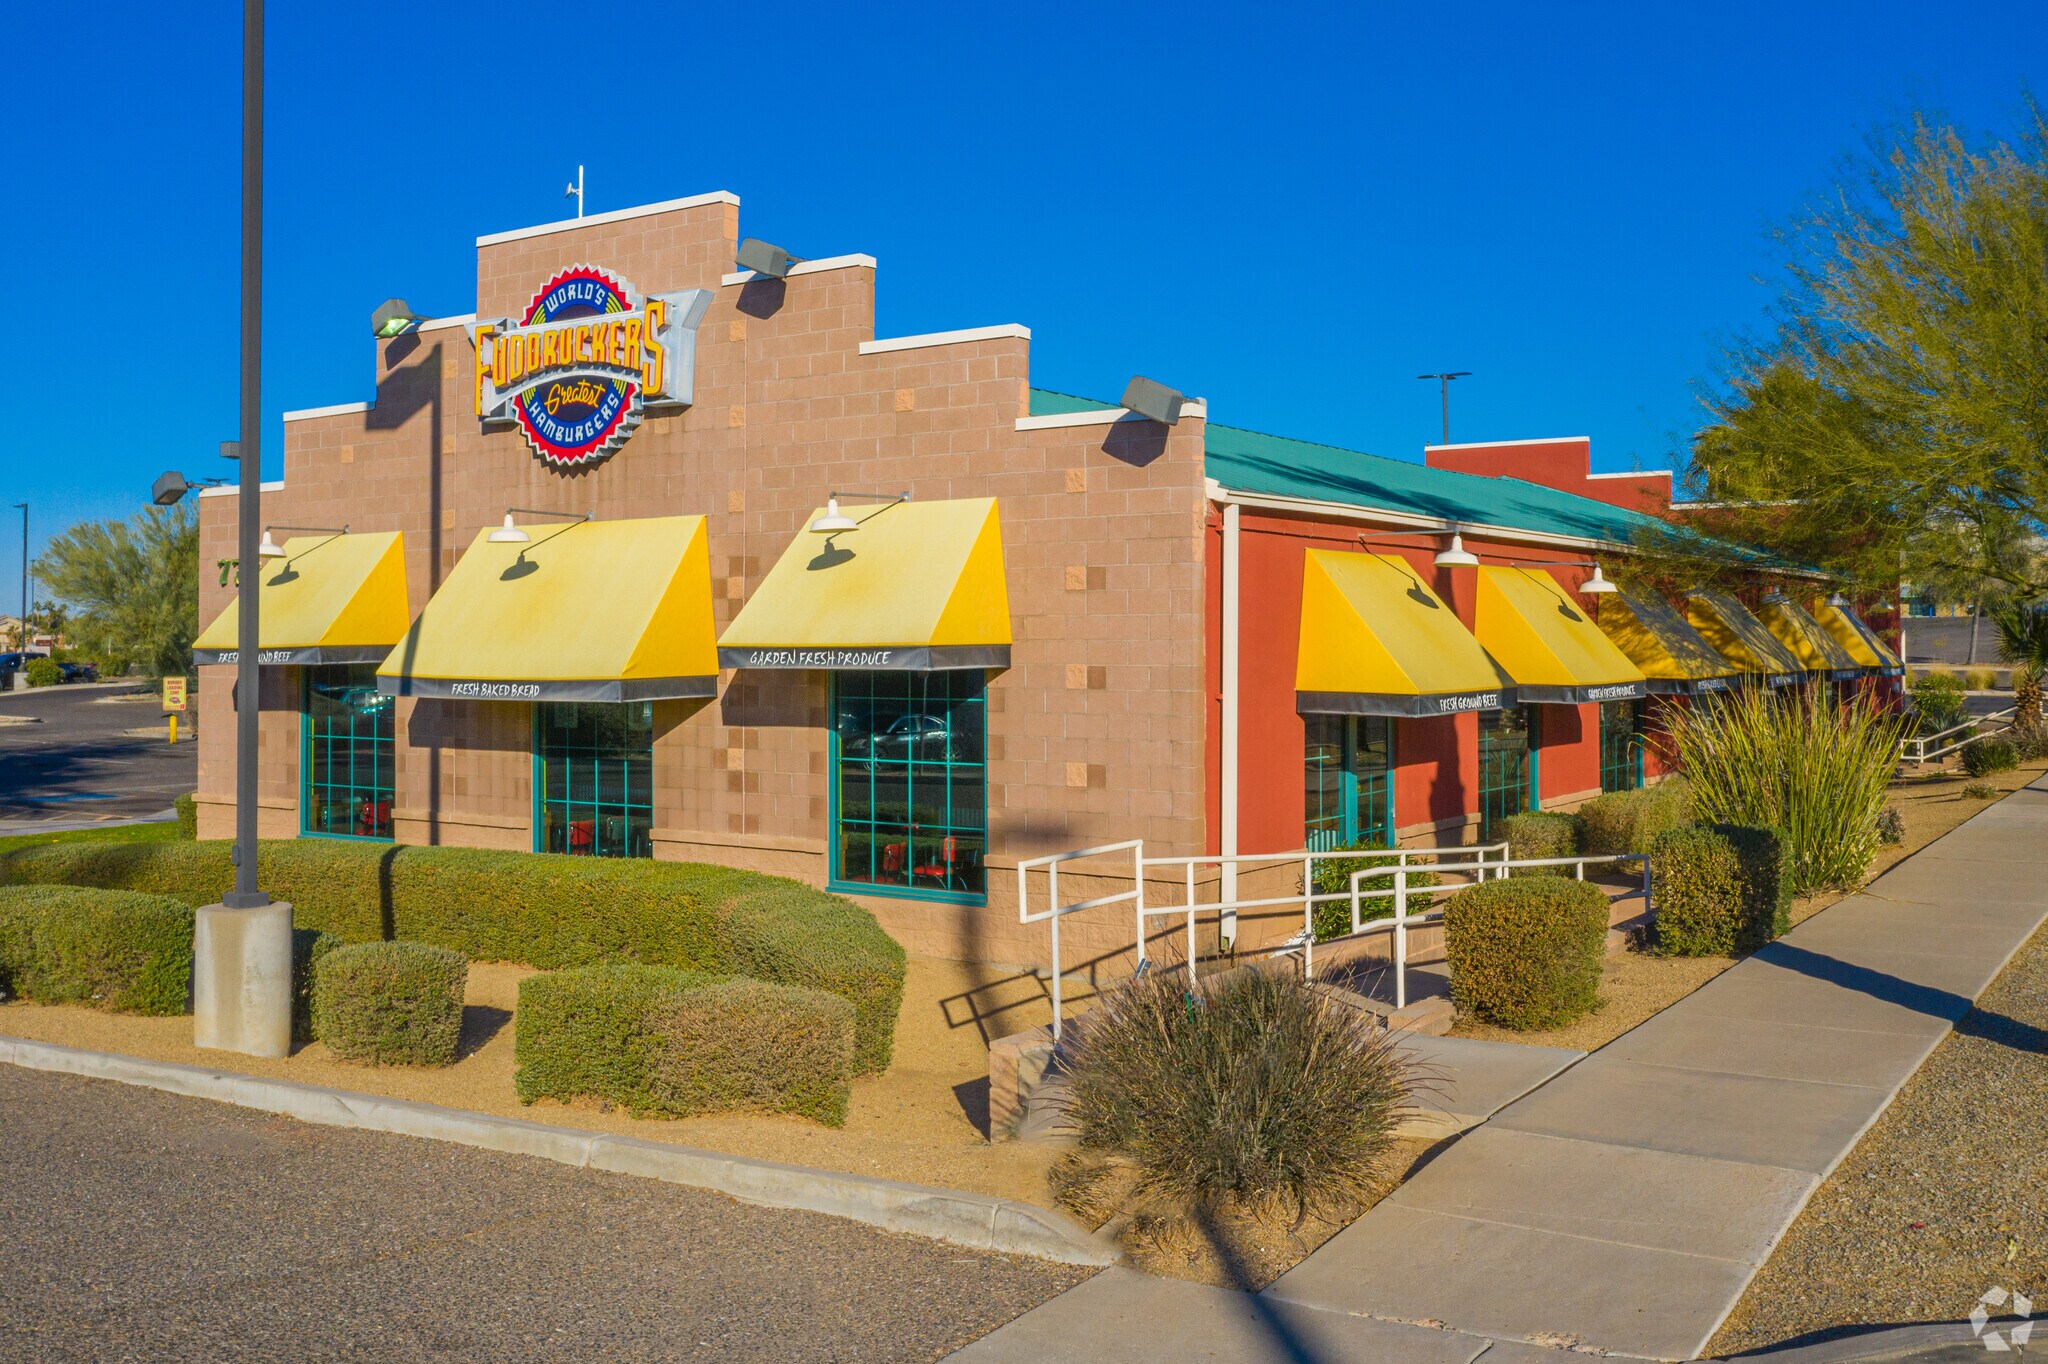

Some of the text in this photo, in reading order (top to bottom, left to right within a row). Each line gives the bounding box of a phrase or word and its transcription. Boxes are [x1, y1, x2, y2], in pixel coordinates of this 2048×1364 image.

[545, 283, 606, 313] WORLD'S
[475, 300, 667, 416] FUDDRUCKERS
[544, 379, 605, 415] Greatest
[529, 393, 620, 443] HAMBURGERS
[273, 650, 292, 663] BEEF
[749, 649, 892, 667] GARDEN FRESH PRODUCE
[451, 682, 540, 699] FRESH BAKED BREAD
[1439, 693, 1498, 712] FRESH GROUND BEEF
